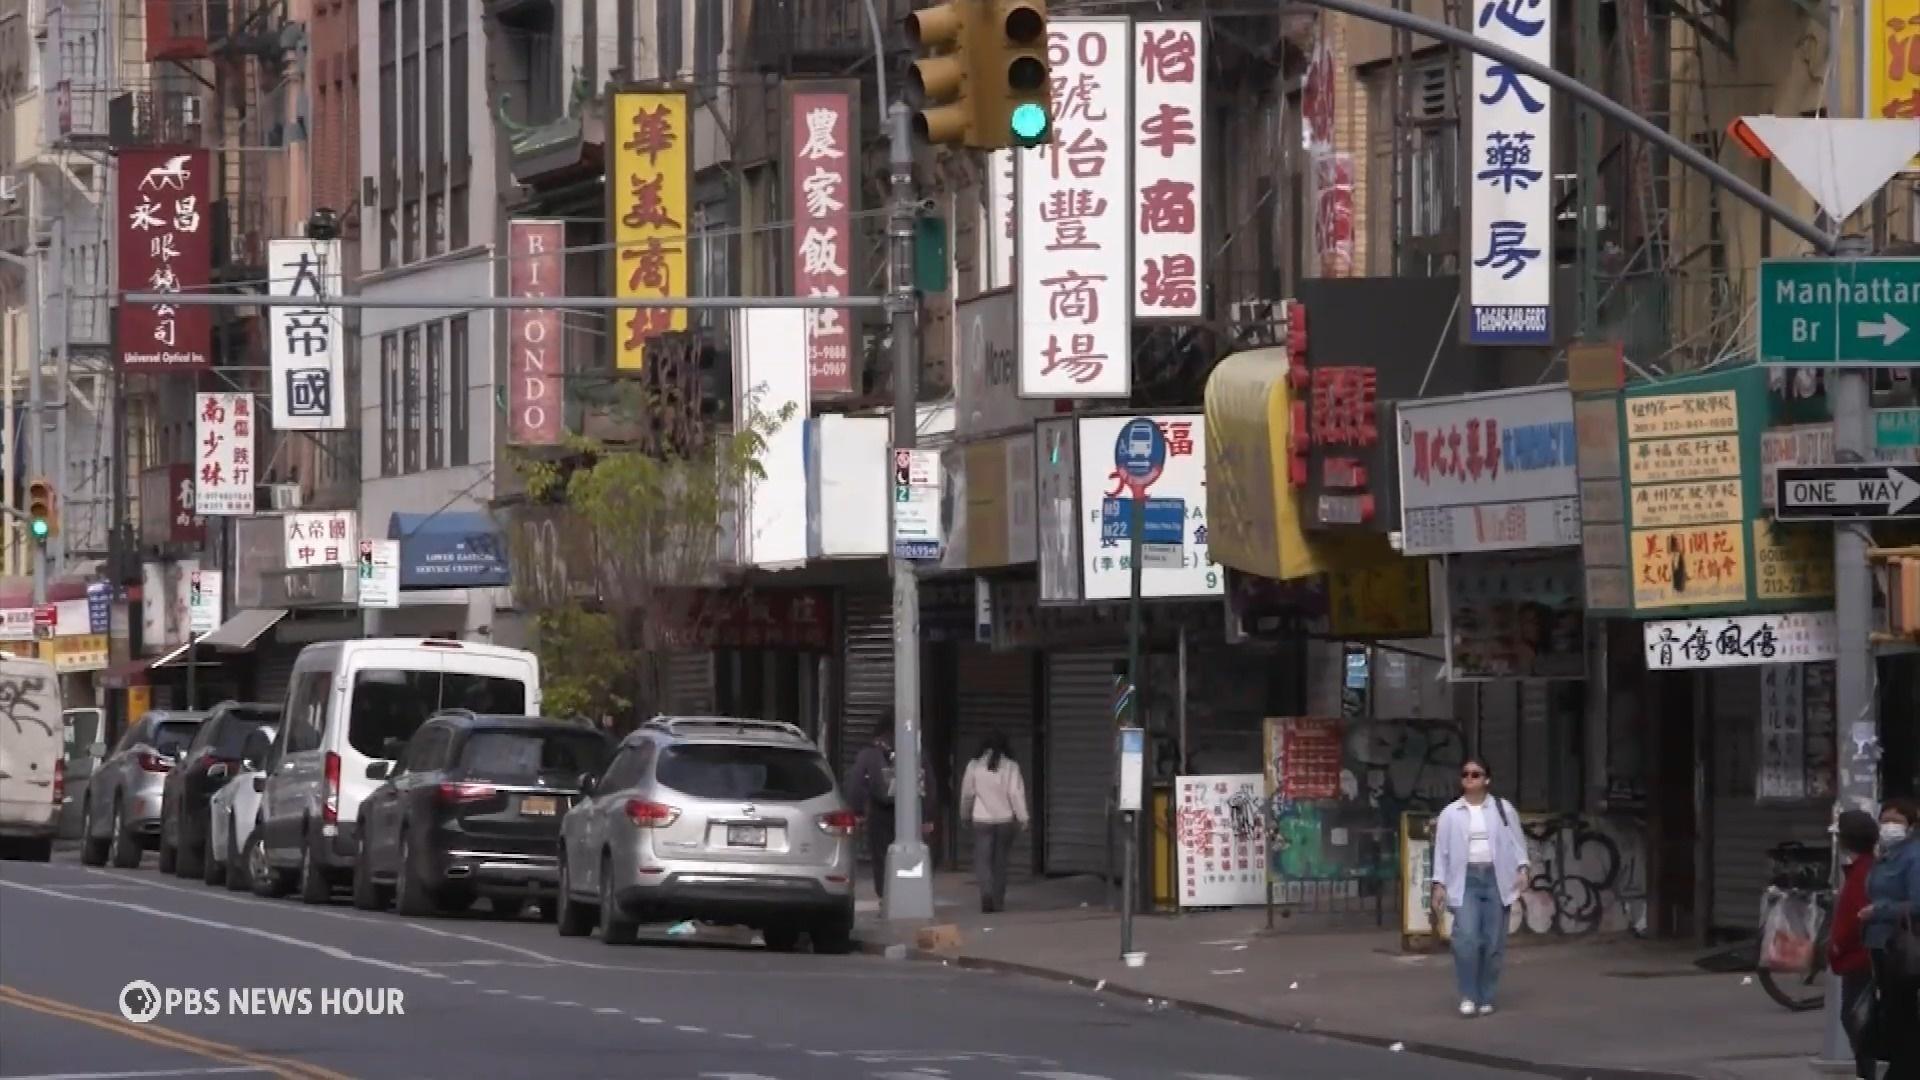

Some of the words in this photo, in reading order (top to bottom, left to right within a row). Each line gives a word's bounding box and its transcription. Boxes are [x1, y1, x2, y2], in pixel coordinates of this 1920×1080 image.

[283, 252, 331, 417] 大帝國
[1792, 318, 1822, 342] Br
[201, 397, 226, 486] 南少林
[1794, 482, 1837, 503] ONE
[1858, 481, 1904, 502] WAY
[1103, 521, 1128, 537] M22
